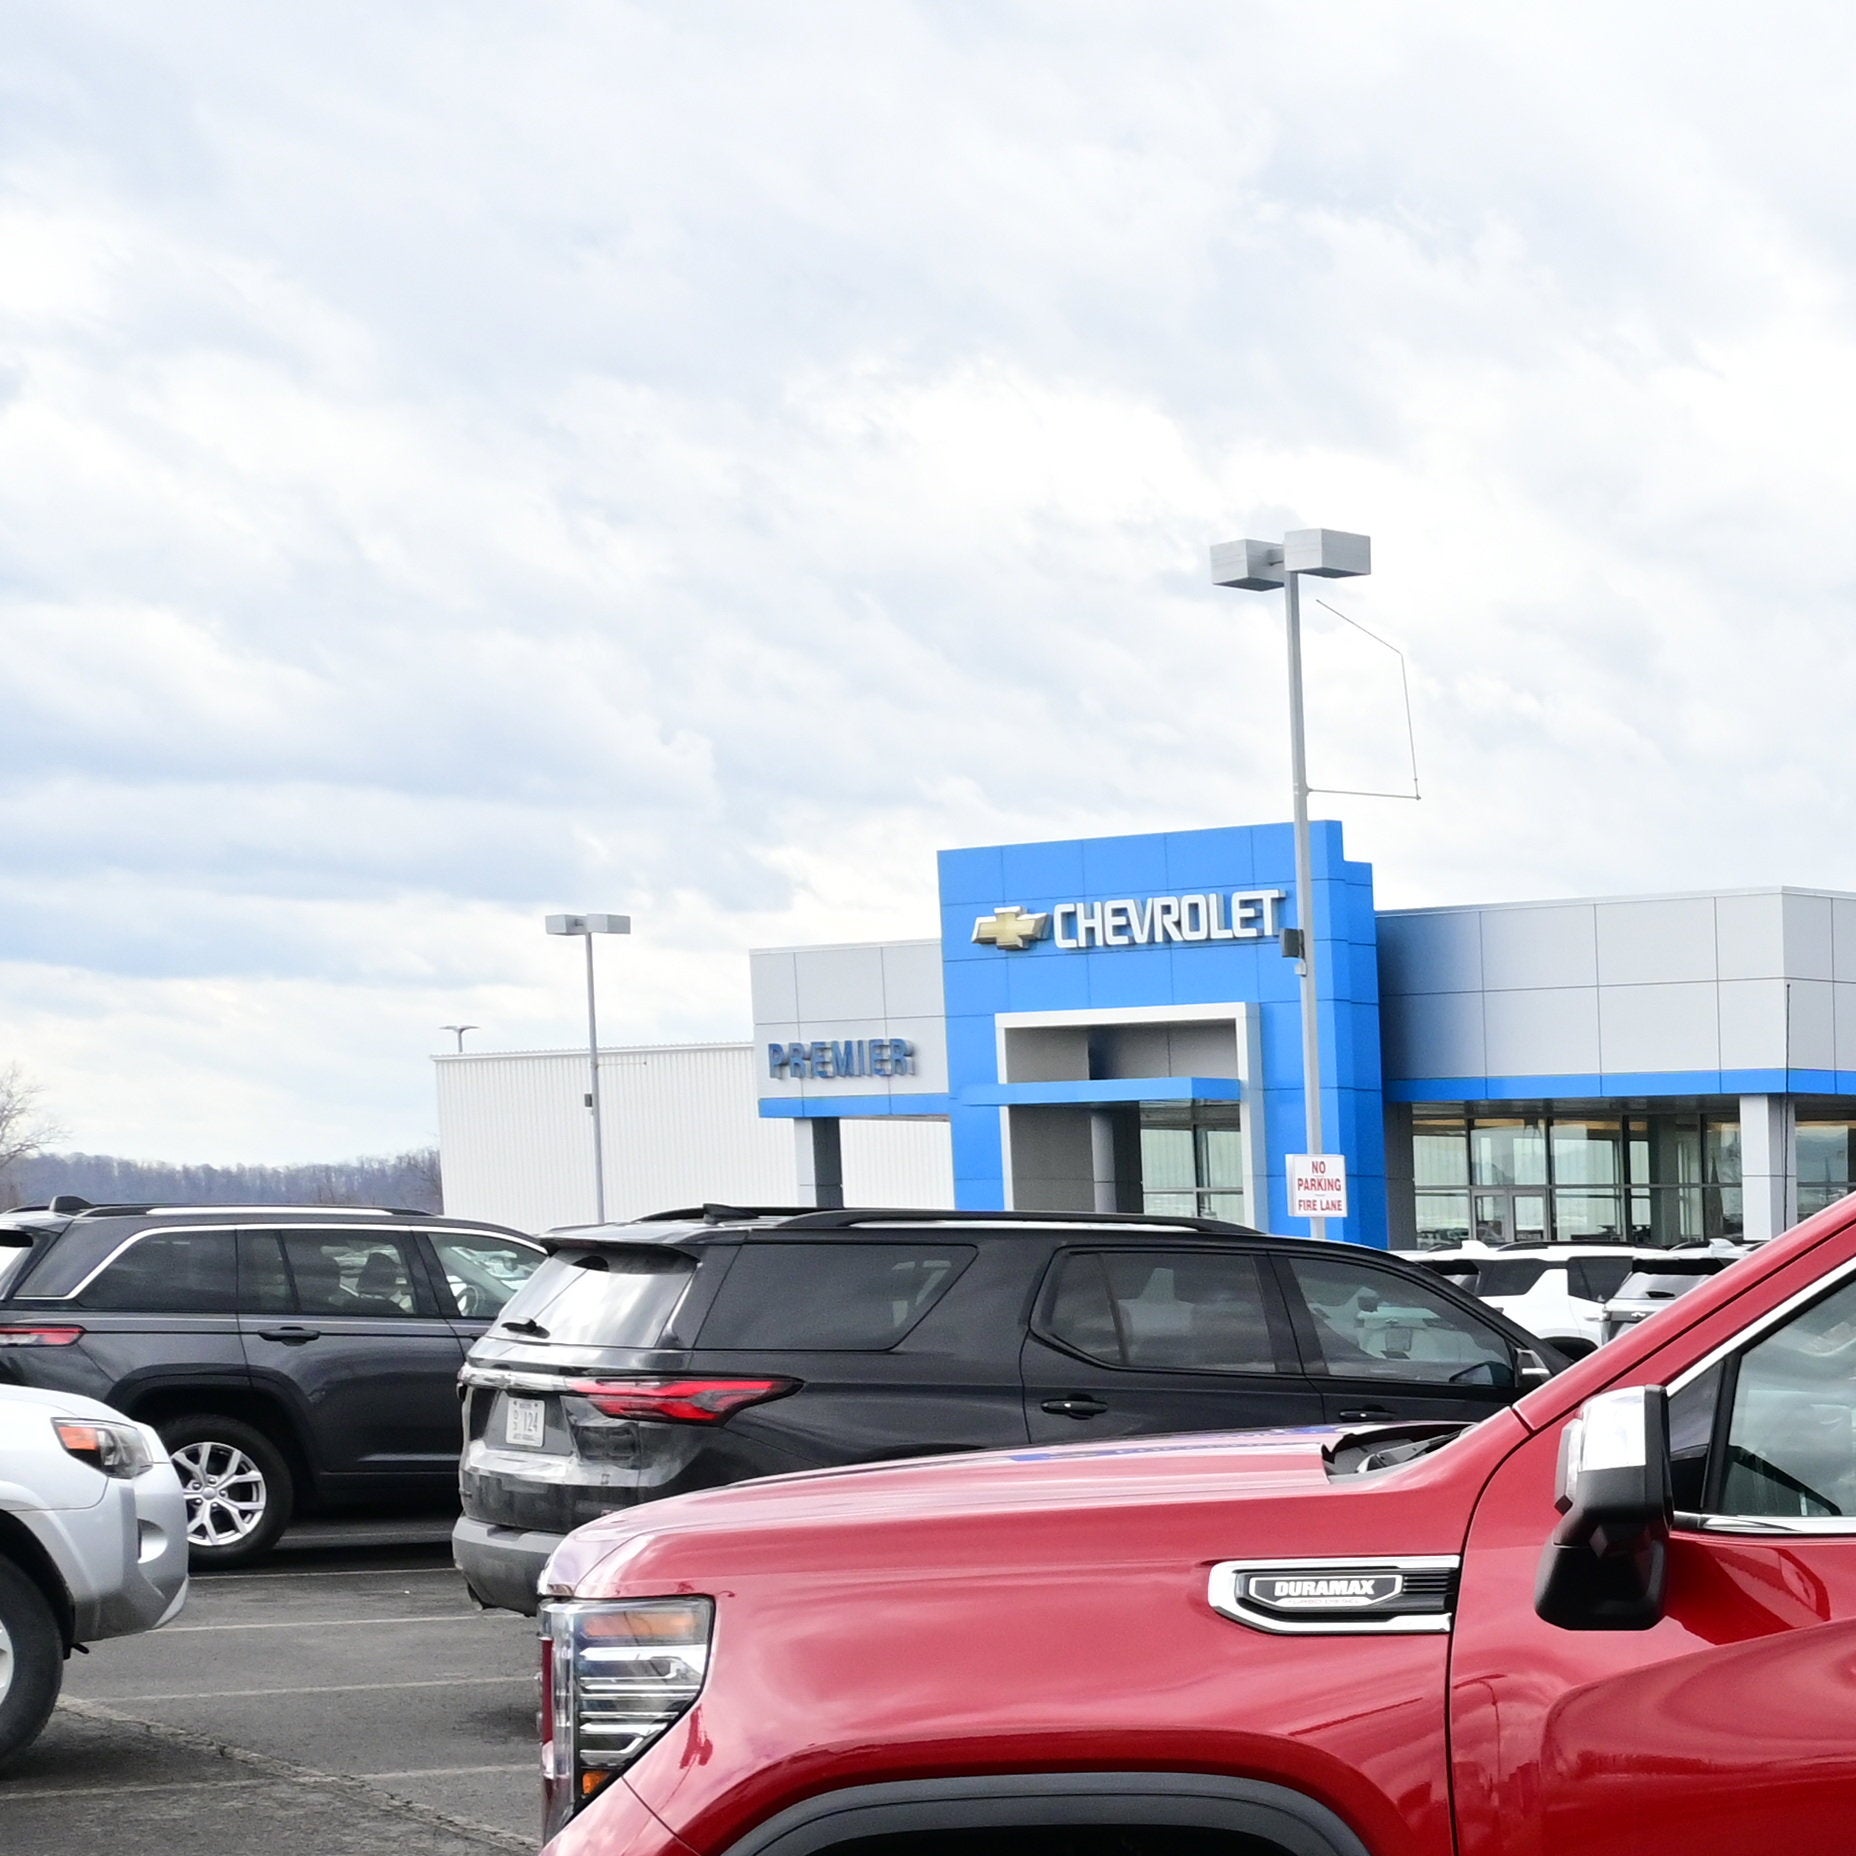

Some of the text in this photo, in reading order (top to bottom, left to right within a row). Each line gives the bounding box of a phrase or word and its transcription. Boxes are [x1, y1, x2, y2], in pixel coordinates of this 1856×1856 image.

[1053, 889, 1280, 949] CHEVROLET
[767, 1038, 914, 1079] PREMIER
[1311, 1160, 1326, 1174] NO
[1297, 1177, 1342, 1192] PARKING
[1298, 1199, 1343, 1211] FIRE LANE
[1274, 1579, 1376, 1597] DURAMAX
